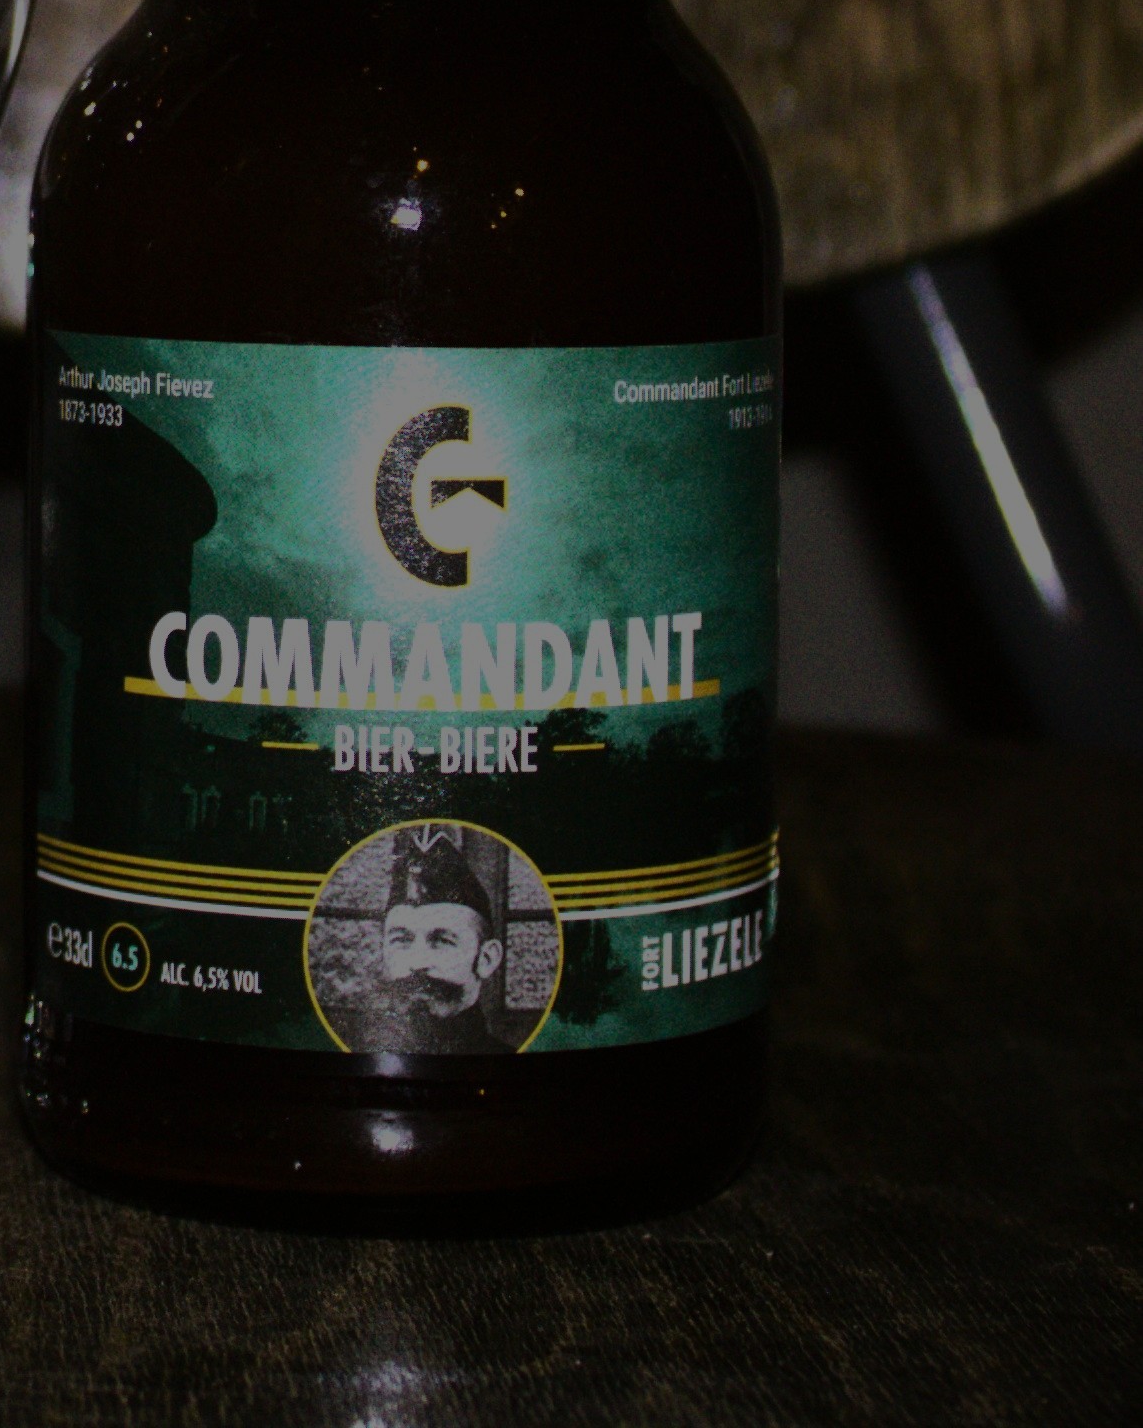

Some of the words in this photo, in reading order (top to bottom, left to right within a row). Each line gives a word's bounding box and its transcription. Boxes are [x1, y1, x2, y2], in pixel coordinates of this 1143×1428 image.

[58, 366, 95, 390] Arthur
[96, 369, 151, 399] Joseph
[155, 372, 215, 399] Fievez
[613, 376, 719, 404] Commandant
[722, 373, 745, 397] Fort
[58, 399, 124, 427] 1873-1933
[148, 610, 703, 711] COMMANDANT
[111, 943, 139, 971] 6.5
[641, 935, 661, 992] FORT
[662, 909, 763, 988] LIEZELE
[160, 962, 190, 987] ALC.
[193, 965, 231, 993] 6,5%
[233, 970, 263, 995] VOL
